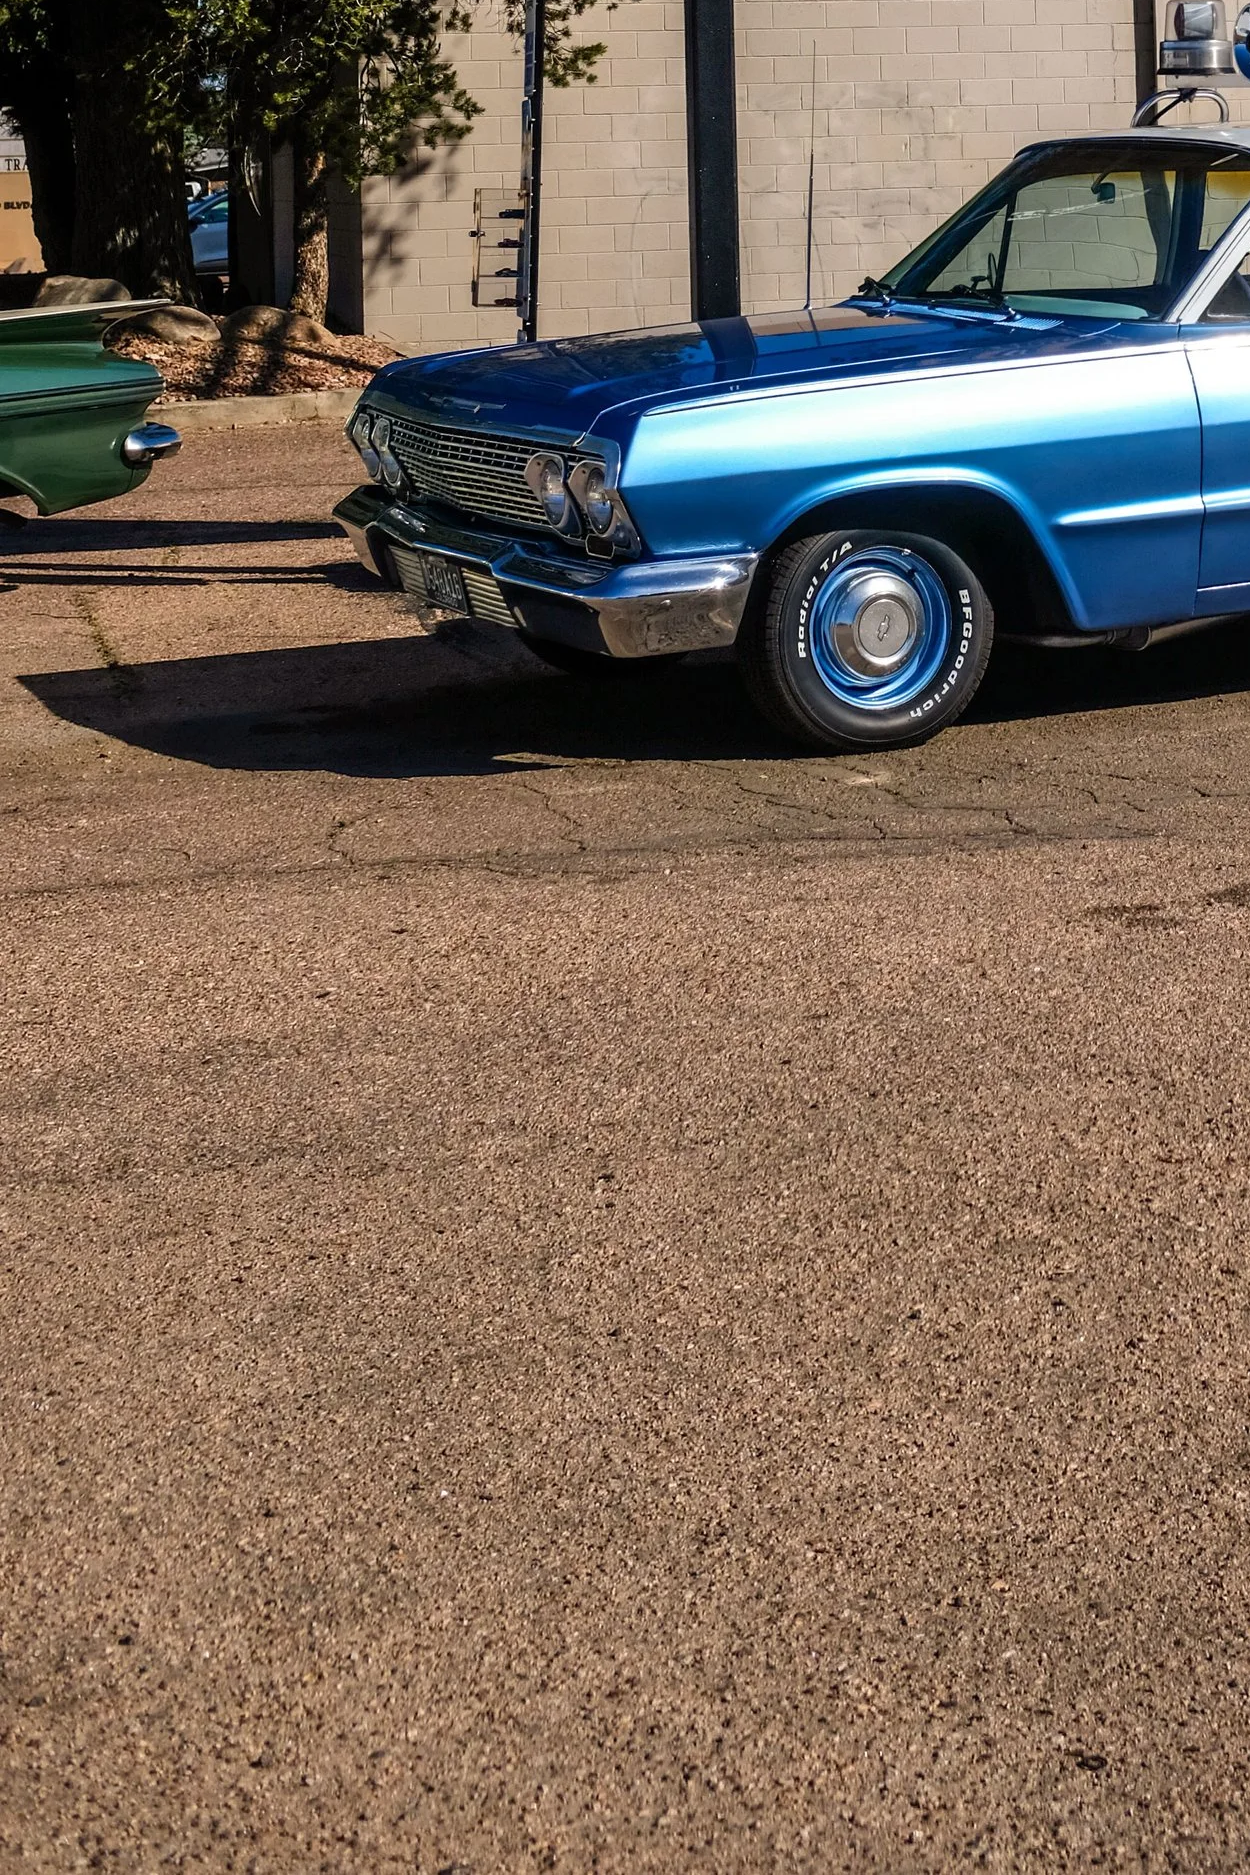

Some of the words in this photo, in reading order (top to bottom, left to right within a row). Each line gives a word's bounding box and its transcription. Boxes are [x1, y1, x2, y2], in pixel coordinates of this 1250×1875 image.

[798, 576, 818, 658] Radial
[820, 541, 853, 572] T/A
[909, 588, 973, 718] BFGoodrich
